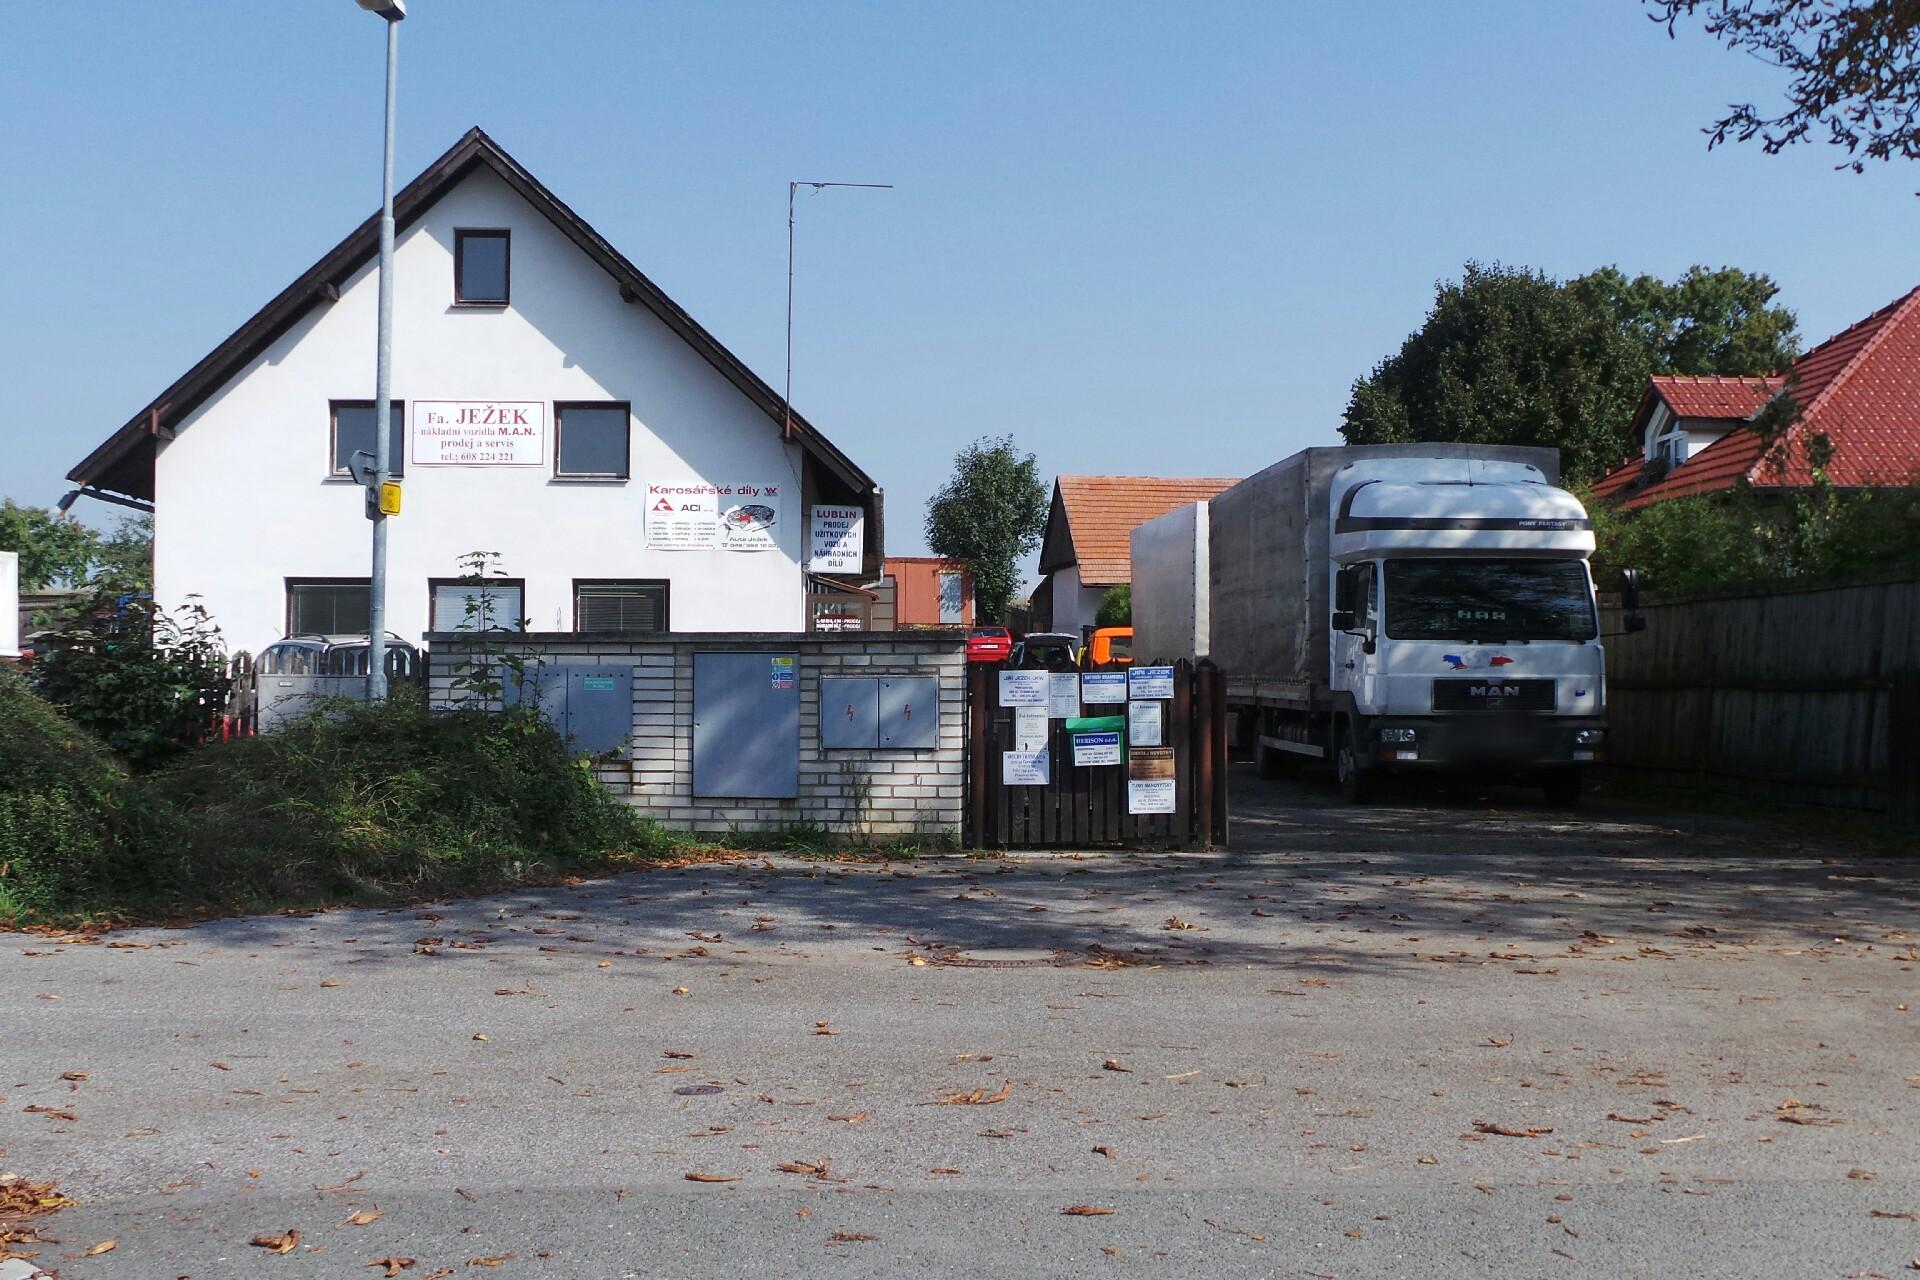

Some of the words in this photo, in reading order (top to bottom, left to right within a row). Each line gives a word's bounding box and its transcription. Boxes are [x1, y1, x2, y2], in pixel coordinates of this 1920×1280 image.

[428, 412, 449, 424] Fa.
[456, 404, 528, 424] JEŽEK
[420, 428, 461, 436] nákladní
[463, 428, 495, 436] vozidla
[498, 427, 536, 436] M.A.N.
[441, 439, 473, 449] prodej
[485, 438, 514, 447] servis
[460, 453, 477, 461] 608
[479, 453, 496, 461] 224
[498, 453, 514, 461] 221
[649, 485, 732, 495] Karosářské
[737, 485, 760, 497] díly
[680, 504, 701, 512] ACI
[816, 510, 857, 519] LUBLIN
[823, 521, 849, 529] PRODEJ
[815, 530, 857, 538] UŽITKOVÝCH
[824, 539, 841, 548] VOZŮ
[814, 549, 858, 558] NÁHRADNÍCH
[828, 558, 843, 567] DÍLŮ
[1470, 686, 1520, 696] MAN
